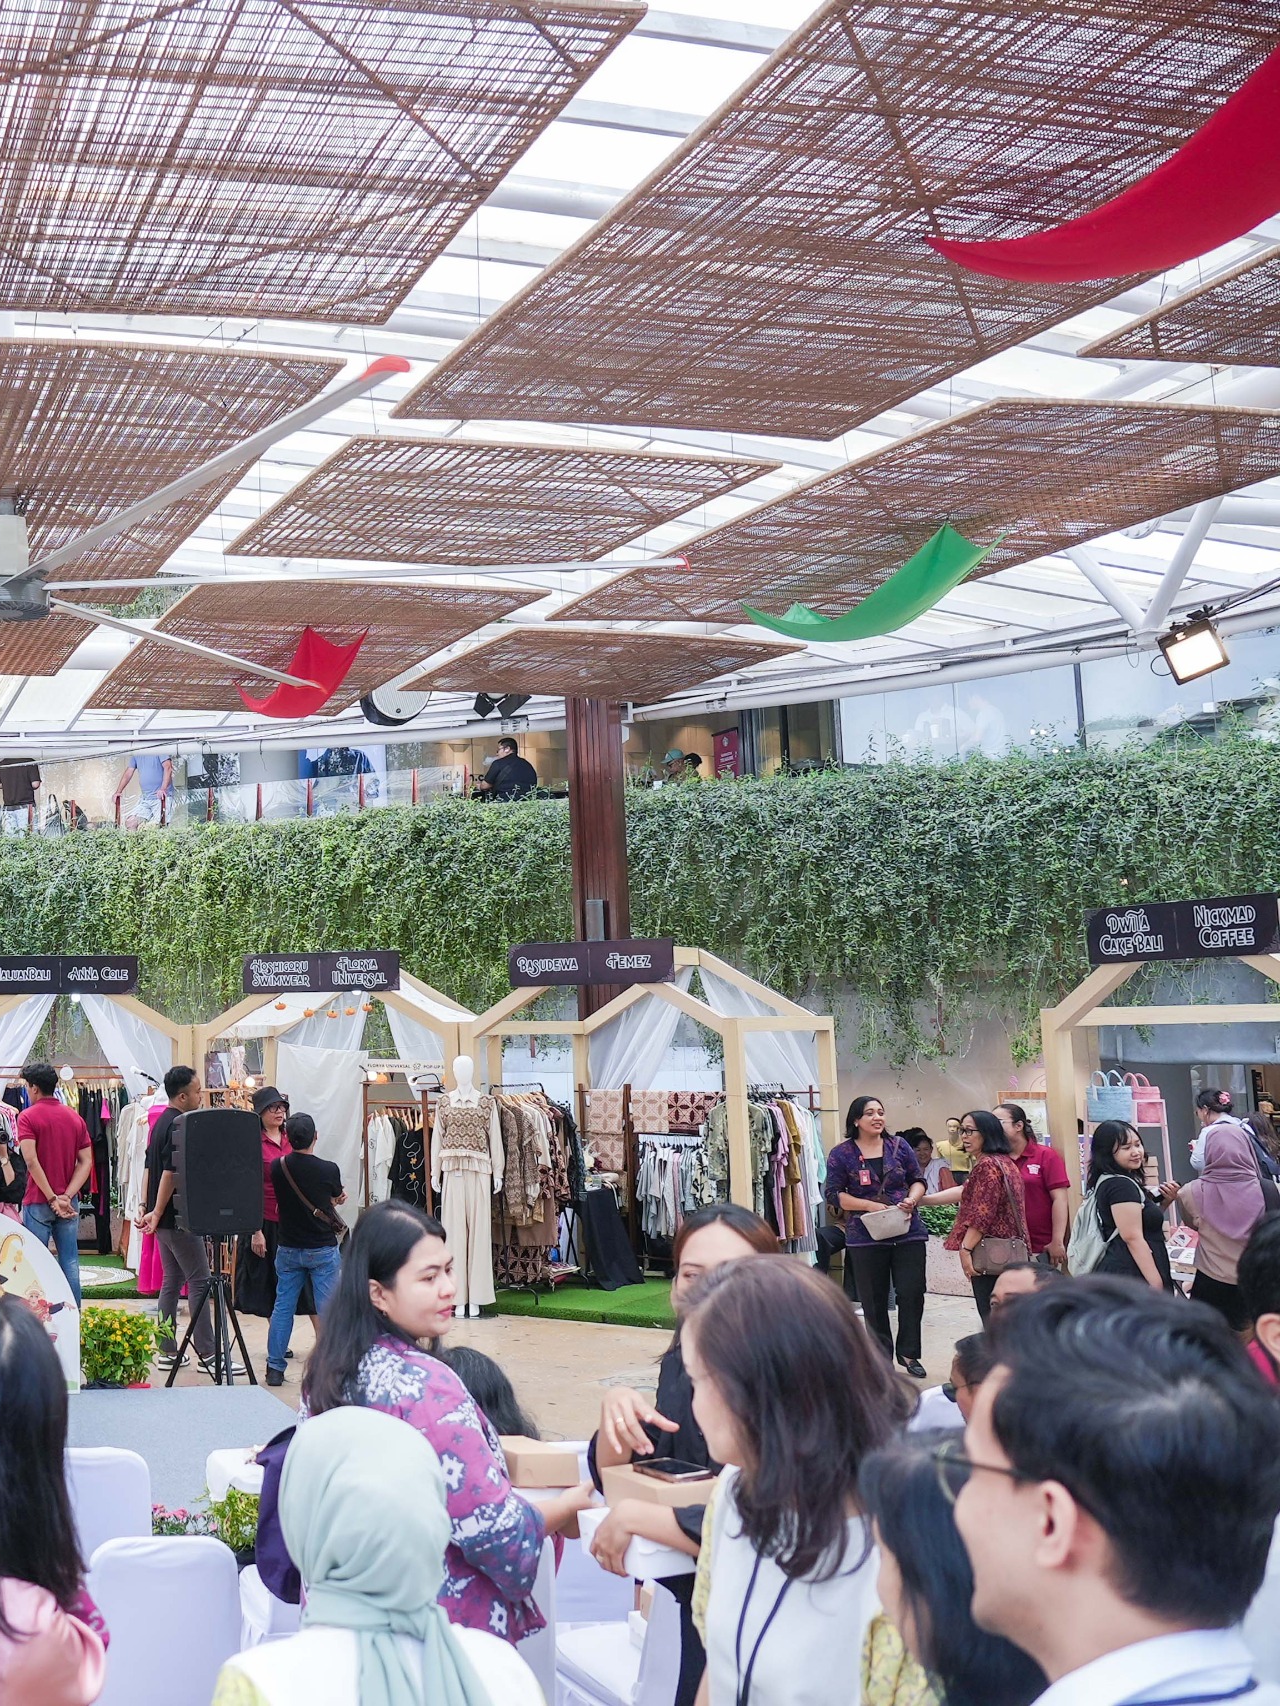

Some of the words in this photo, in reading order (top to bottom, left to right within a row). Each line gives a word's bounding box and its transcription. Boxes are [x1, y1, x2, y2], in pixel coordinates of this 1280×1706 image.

[1105, 908, 1150, 934] DWITA
[1193, 905, 1256, 928] NICKMAD
[1099, 934, 1133, 956] CAKE
[1132, 932, 1164, 953] BALI
[1198, 926, 1255, 949] COFFEE
[67, 966, 99, 981] ANNA
[100, 966, 129, 981] COLE
[335, 956, 379, 972] FLORYA
[516, 956, 579, 978] BASUDEWA
[251, 972, 311, 987] SWIMWEAR
[331, 970, 388, 989] UNIVERSAL
